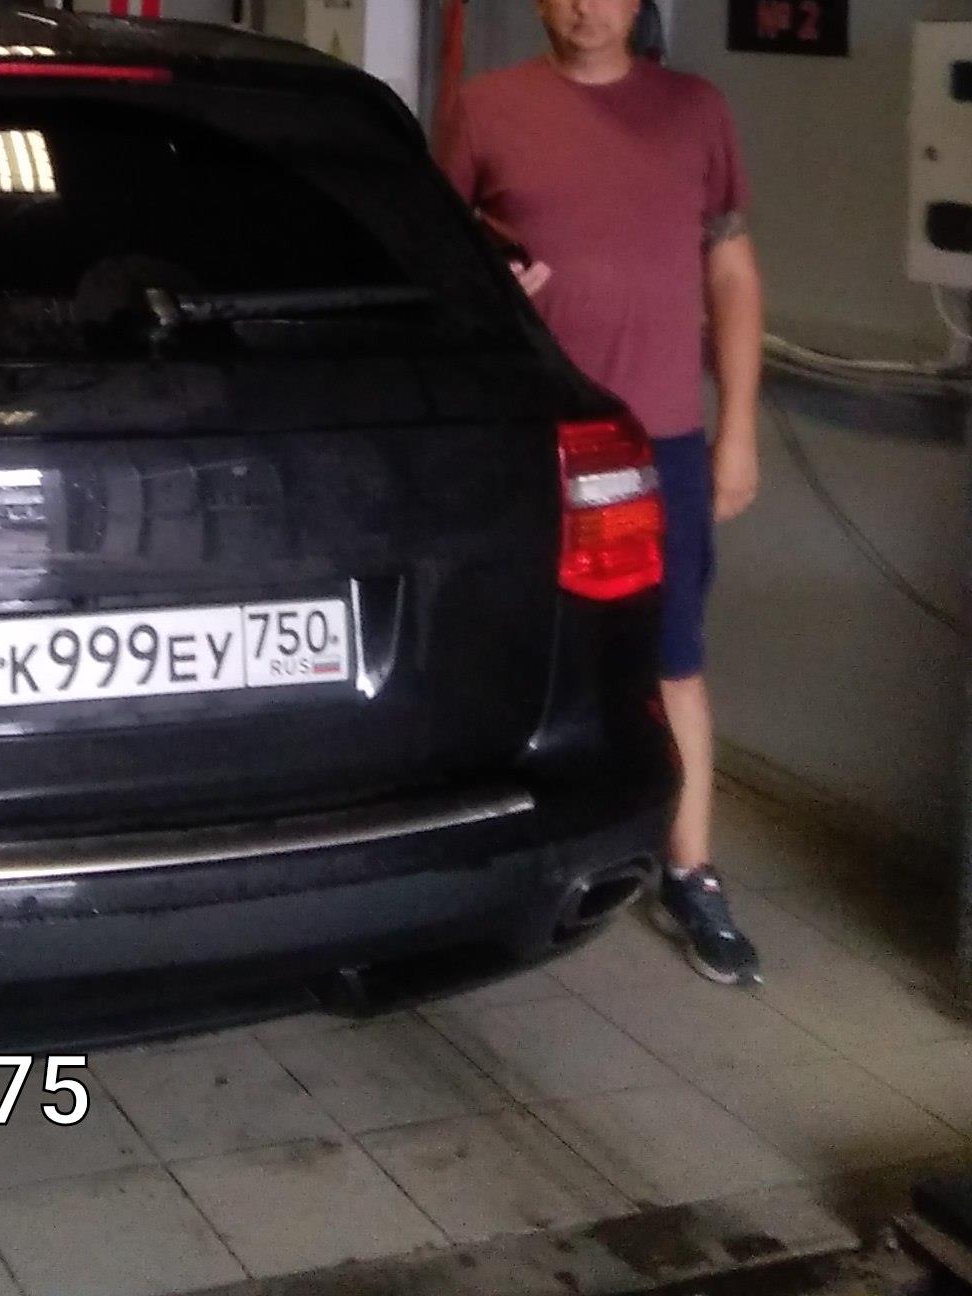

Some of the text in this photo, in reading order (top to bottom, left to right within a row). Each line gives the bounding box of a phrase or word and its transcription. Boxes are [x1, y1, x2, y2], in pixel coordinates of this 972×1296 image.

[9, 609, 329, 695] К999ЕУ 750
[269, 658, 312, 676] RUS
